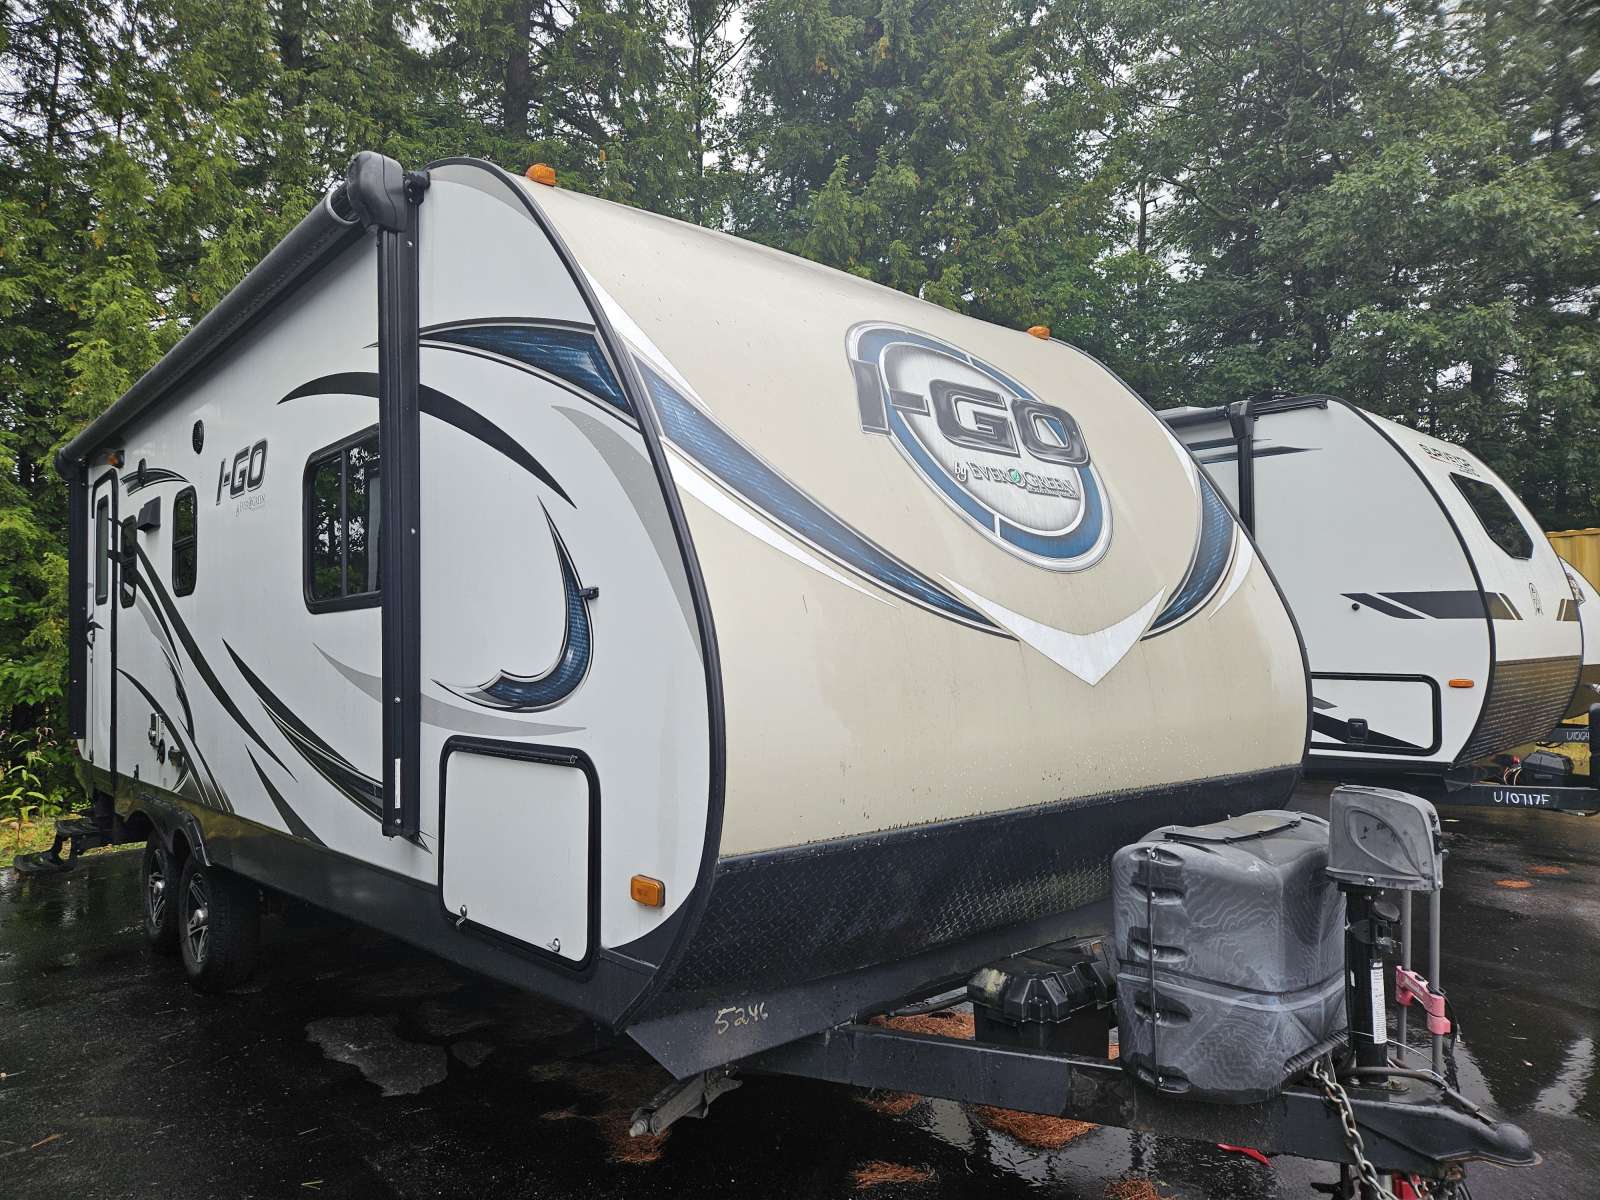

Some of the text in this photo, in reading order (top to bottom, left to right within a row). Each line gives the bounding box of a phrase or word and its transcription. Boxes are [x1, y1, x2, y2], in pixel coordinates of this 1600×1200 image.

[853, 359, 1091, 469] I-GO
[216, 438, 267, 506] I-GO
[1493, 790, 1551, 806] U10717F
